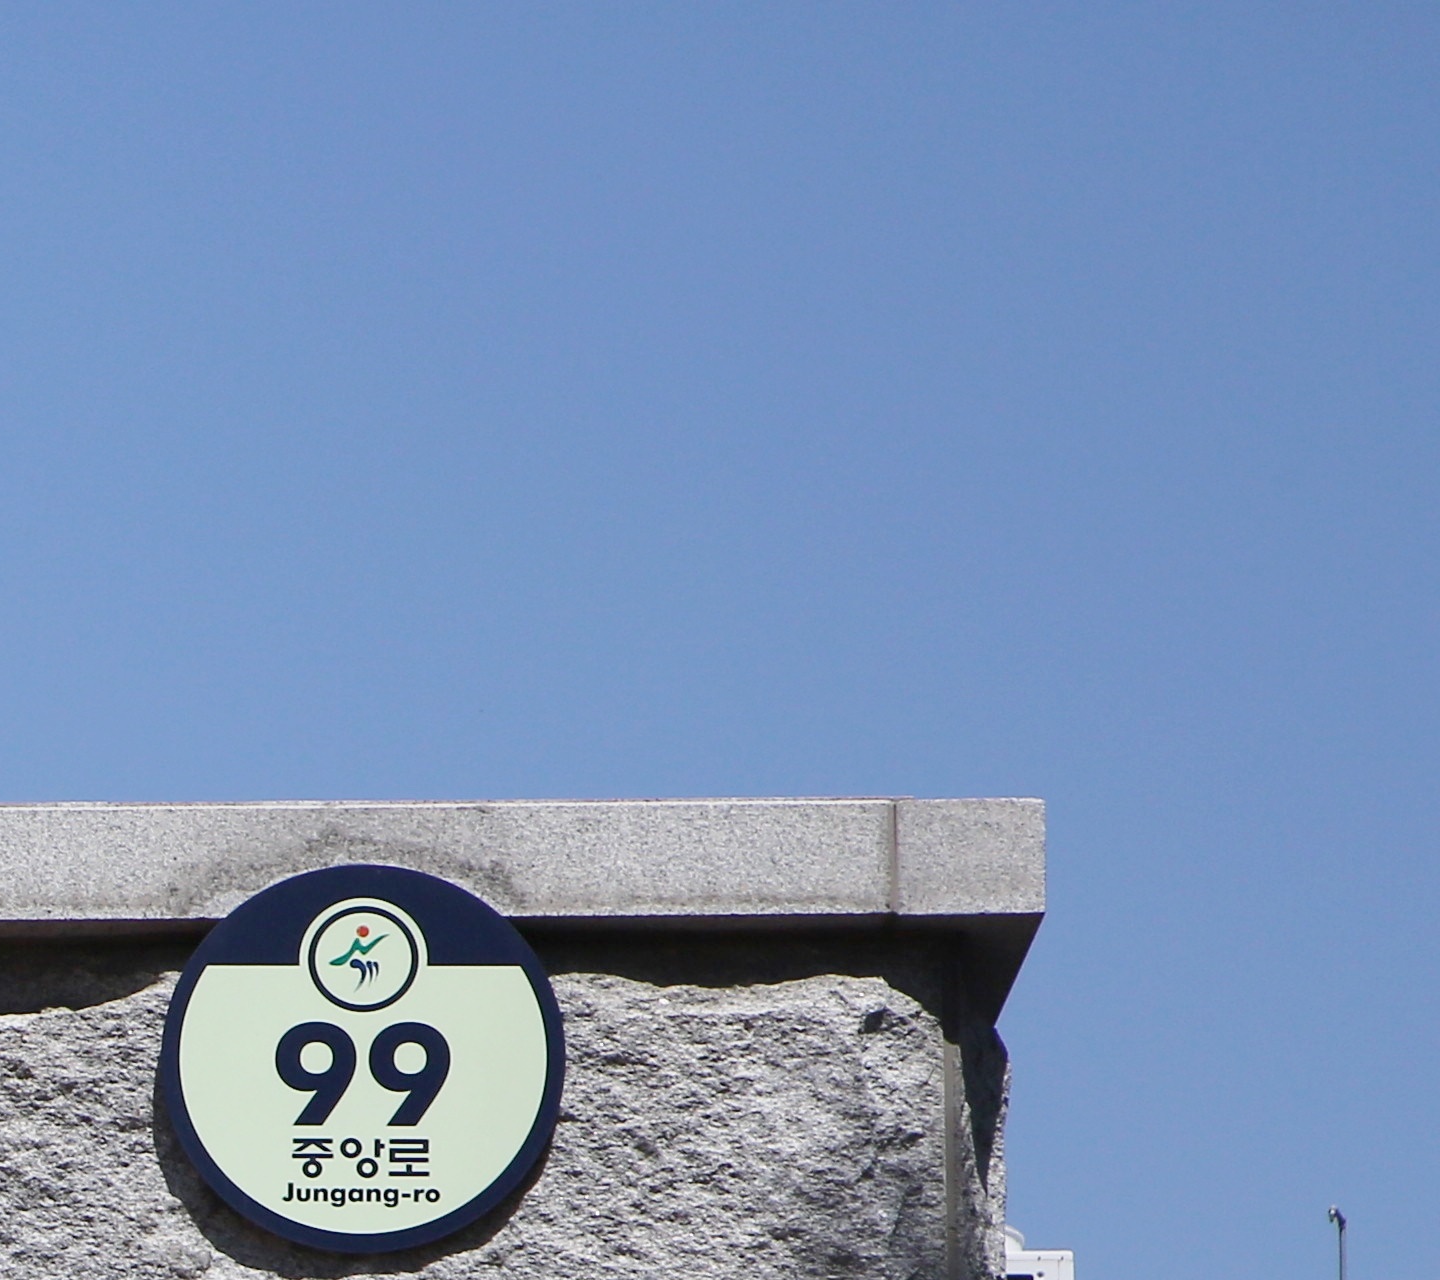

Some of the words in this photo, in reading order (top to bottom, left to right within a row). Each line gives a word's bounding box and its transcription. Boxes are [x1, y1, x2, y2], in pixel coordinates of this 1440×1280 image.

[275, 1021, 451, 1127] 99
[291, 1137, 430, 1179] 중앙로
[282, 1182, 441, 1208] Jungang-ro
